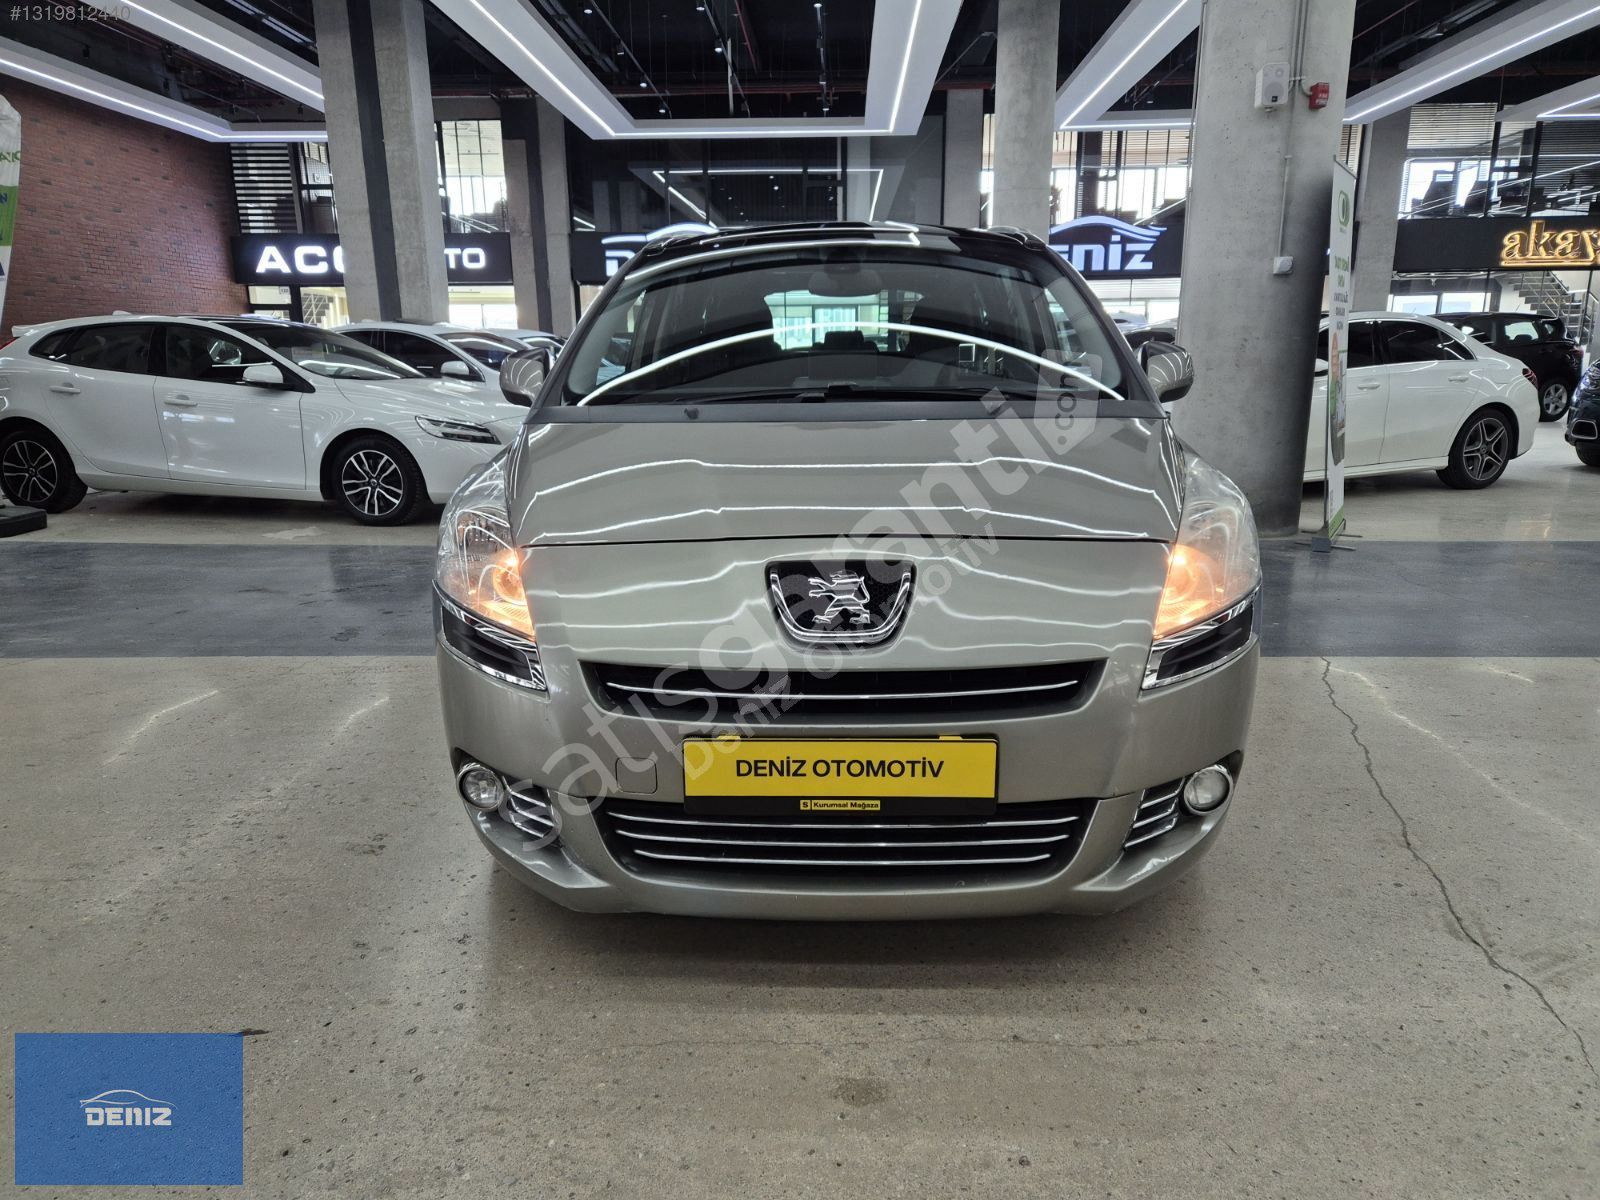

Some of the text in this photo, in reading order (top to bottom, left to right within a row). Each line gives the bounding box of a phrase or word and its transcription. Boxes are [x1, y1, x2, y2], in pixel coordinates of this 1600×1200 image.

[735, 756, 945, 778] DENİZ OTOMOTİV
[813, 801, 848, 809] Kurumsal
[850, 801, 879, 810] Mağaza
